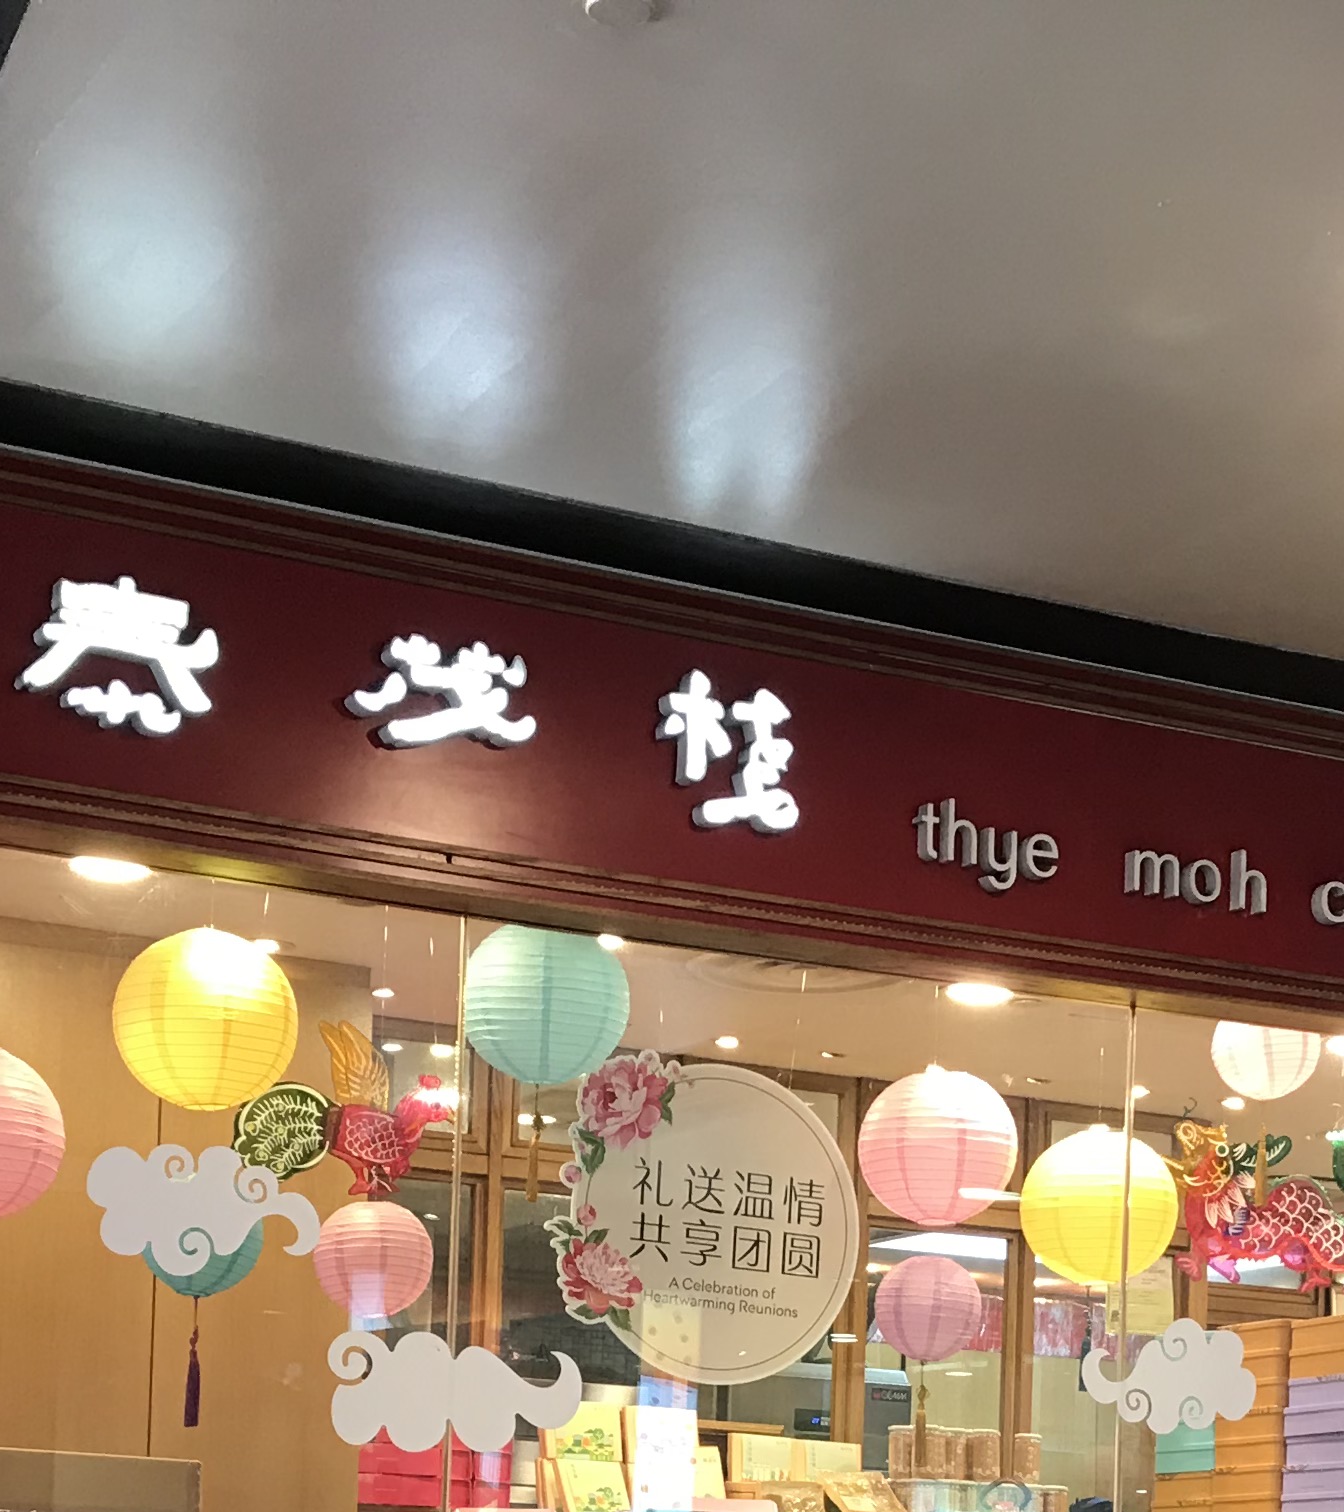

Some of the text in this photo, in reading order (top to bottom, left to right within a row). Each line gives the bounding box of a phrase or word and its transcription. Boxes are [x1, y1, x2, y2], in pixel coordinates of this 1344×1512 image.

[912, 797, 1059, 893] thye
[1123, 848, 1268, 916] moh
[632, 1156, 825, 1228] 礼送温情
[629, 1212, 820, 1279] 共享团圆
[643, 1289, 799, 1319] Heartwarming Reunions
[669, 1277, 777, 1300] A Celebration of
